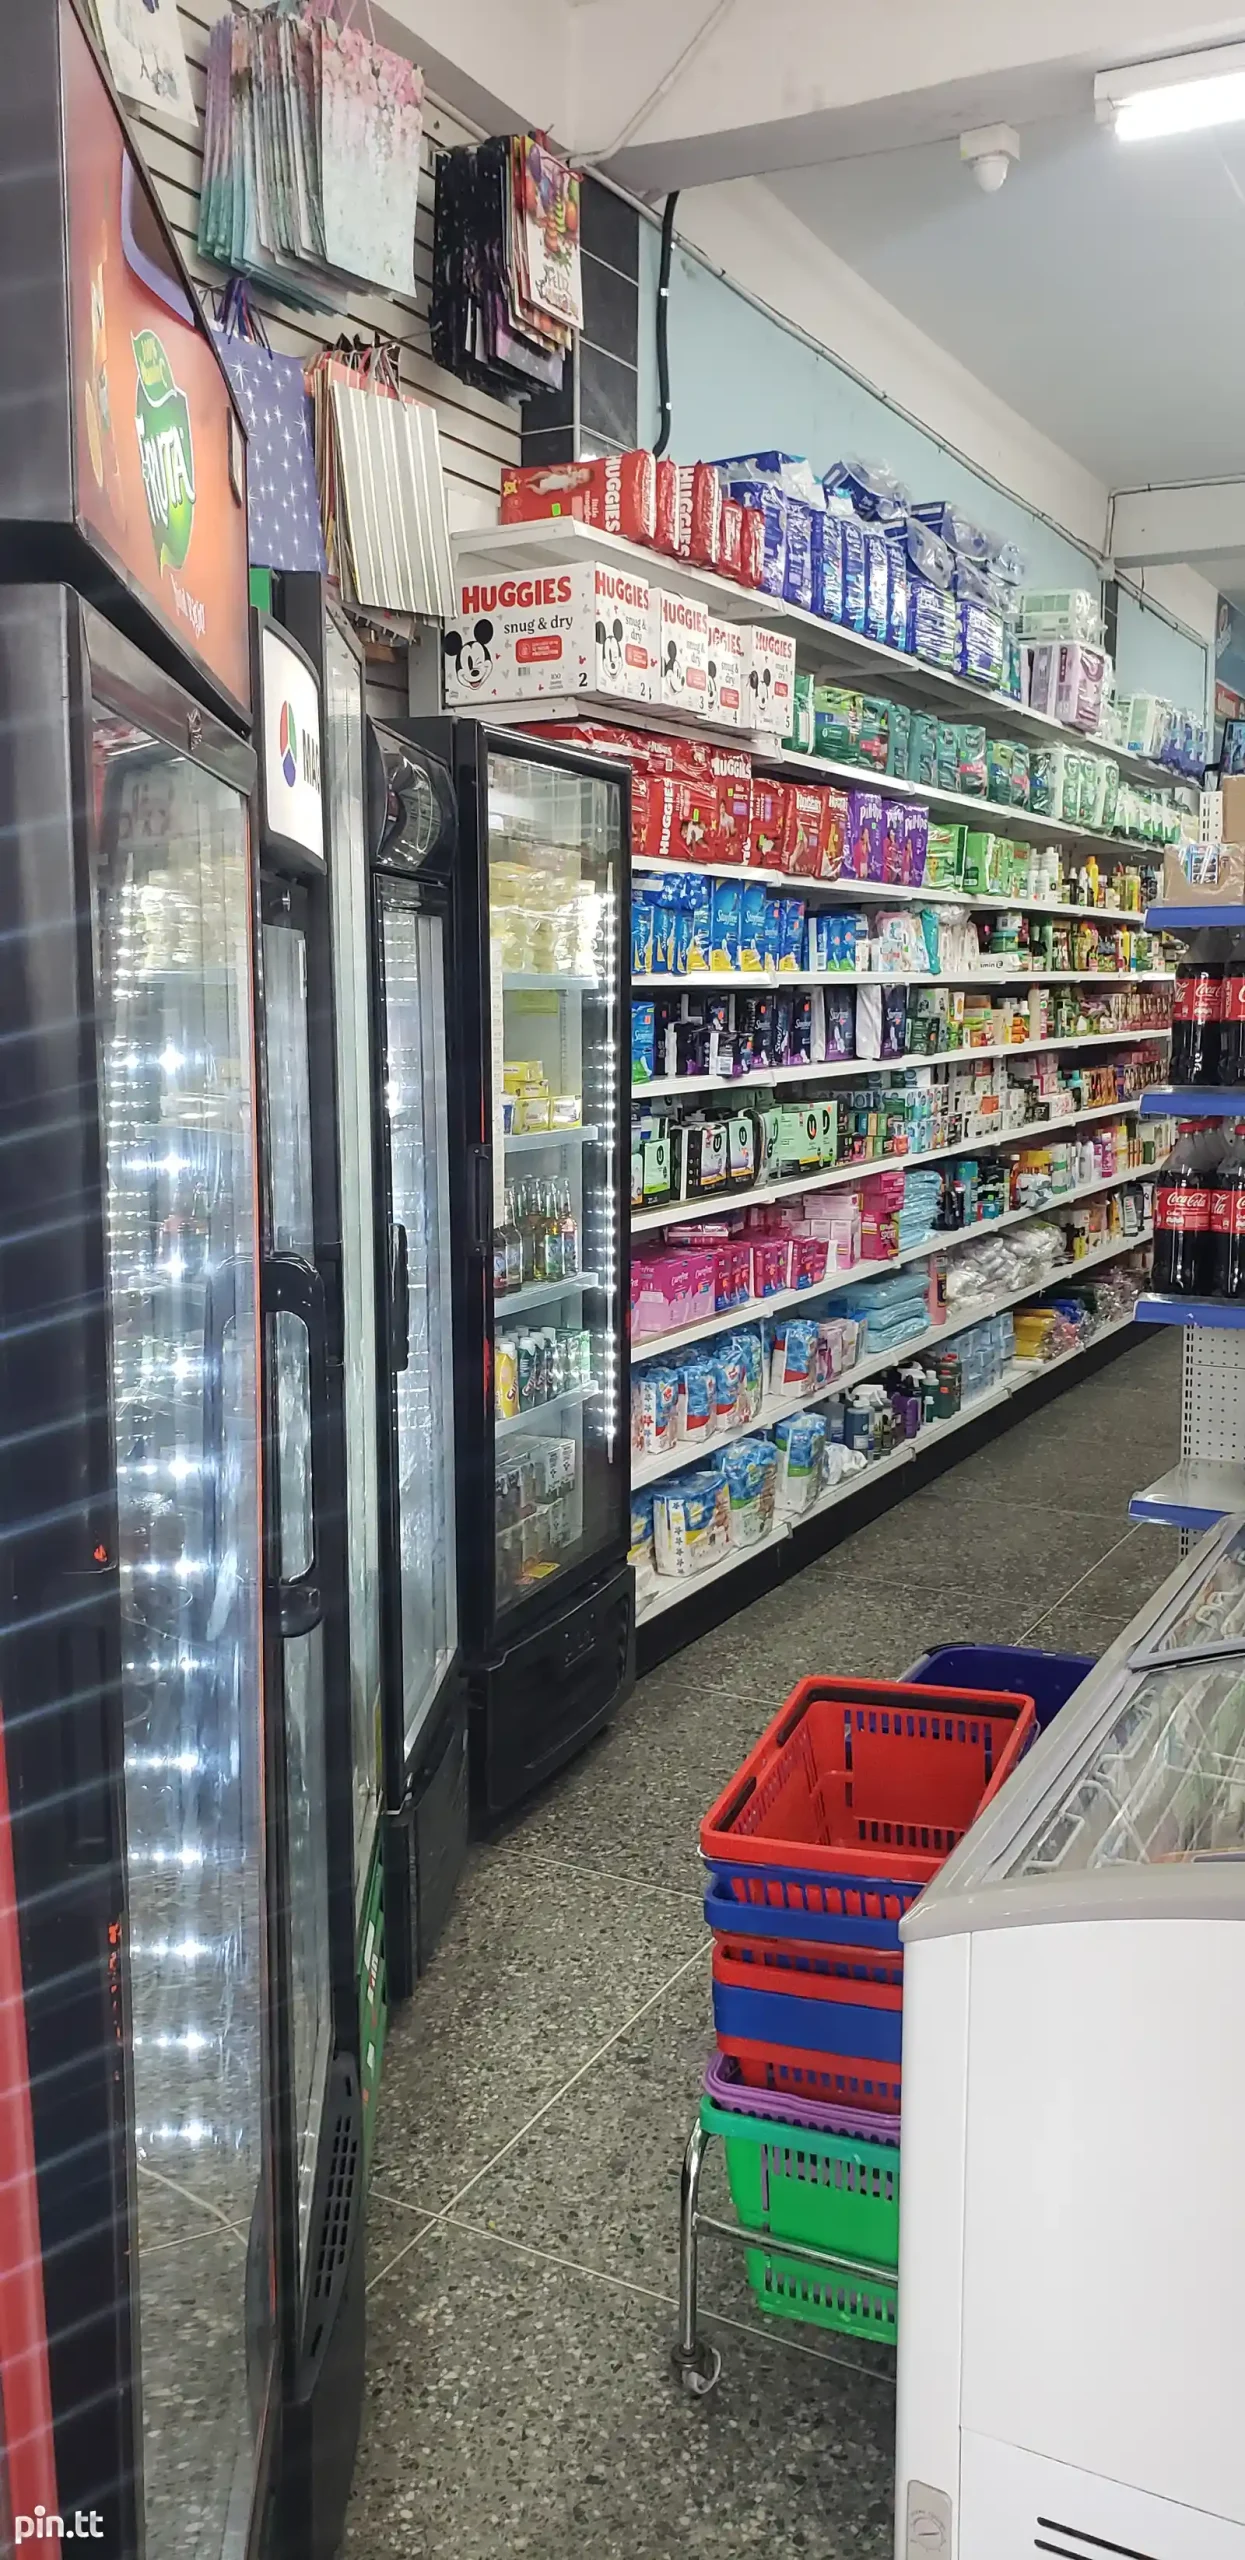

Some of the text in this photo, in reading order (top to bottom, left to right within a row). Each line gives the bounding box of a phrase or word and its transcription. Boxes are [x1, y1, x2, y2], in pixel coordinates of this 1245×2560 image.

[604, 454, 622, 532] HUGGIES
[679, 467, 694, 557] HUGGIES
[462, 575, 572, 615] HUGGIES
[595, 570, 649, 611] HUGGIES
[503, 614, 574, 634] snug & dry
[625, 616, 641, 631] snug
[630, 628, 643, 644] dry
[755, 631, 793, 660] HUGGIES
[578, 672, 588, 687] 2
[640, 682, 646, 697] 2
[699, 696, 705, 710] 3
[732, 710, 738, 724] 4
[785, 715, 791, 729] 5
[659, 777, 674, 855] HUGGIES
